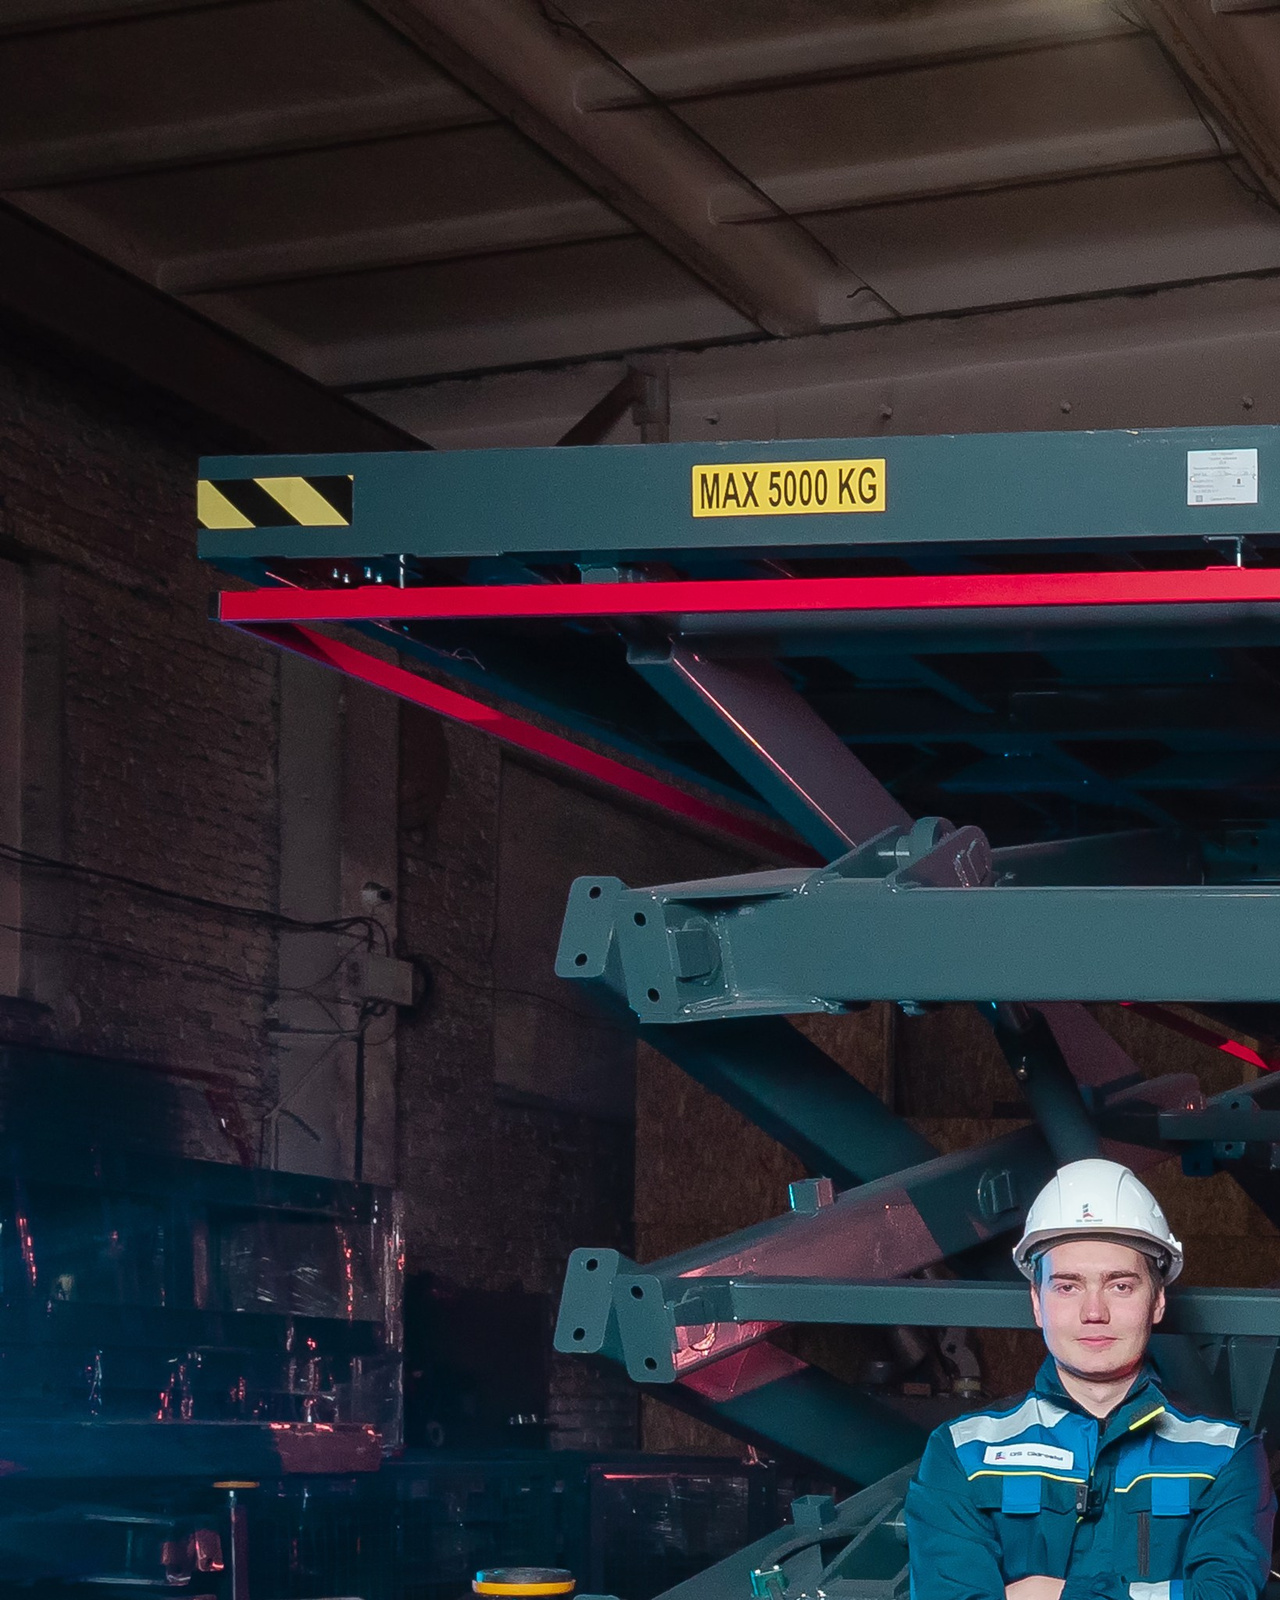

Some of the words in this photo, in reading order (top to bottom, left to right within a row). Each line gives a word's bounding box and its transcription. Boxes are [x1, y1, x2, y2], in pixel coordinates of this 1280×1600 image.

[700, 471, 760, 509] MAX
[768, 469, 828, 507] 5000
[838, 466, 877, 504] KG
